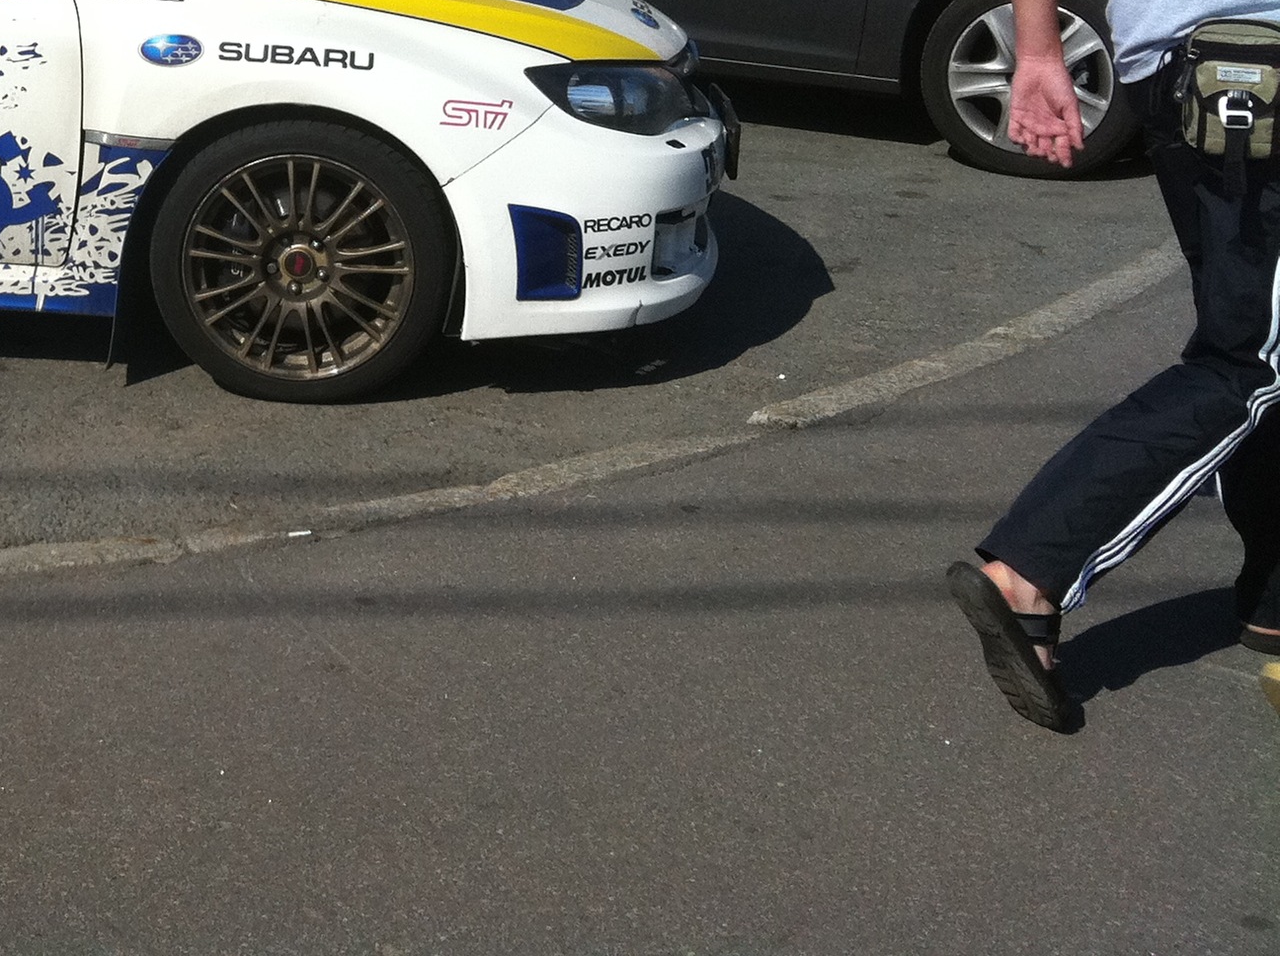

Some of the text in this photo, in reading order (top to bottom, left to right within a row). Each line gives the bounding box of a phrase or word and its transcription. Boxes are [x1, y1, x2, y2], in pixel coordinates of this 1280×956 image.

[218, 42, 375, 71] SUBARU
[584, 213, 652, 234] RECARO
[584, 240, 651, 260] EXEDY
[582, 266, 647, 289] MOTUL
